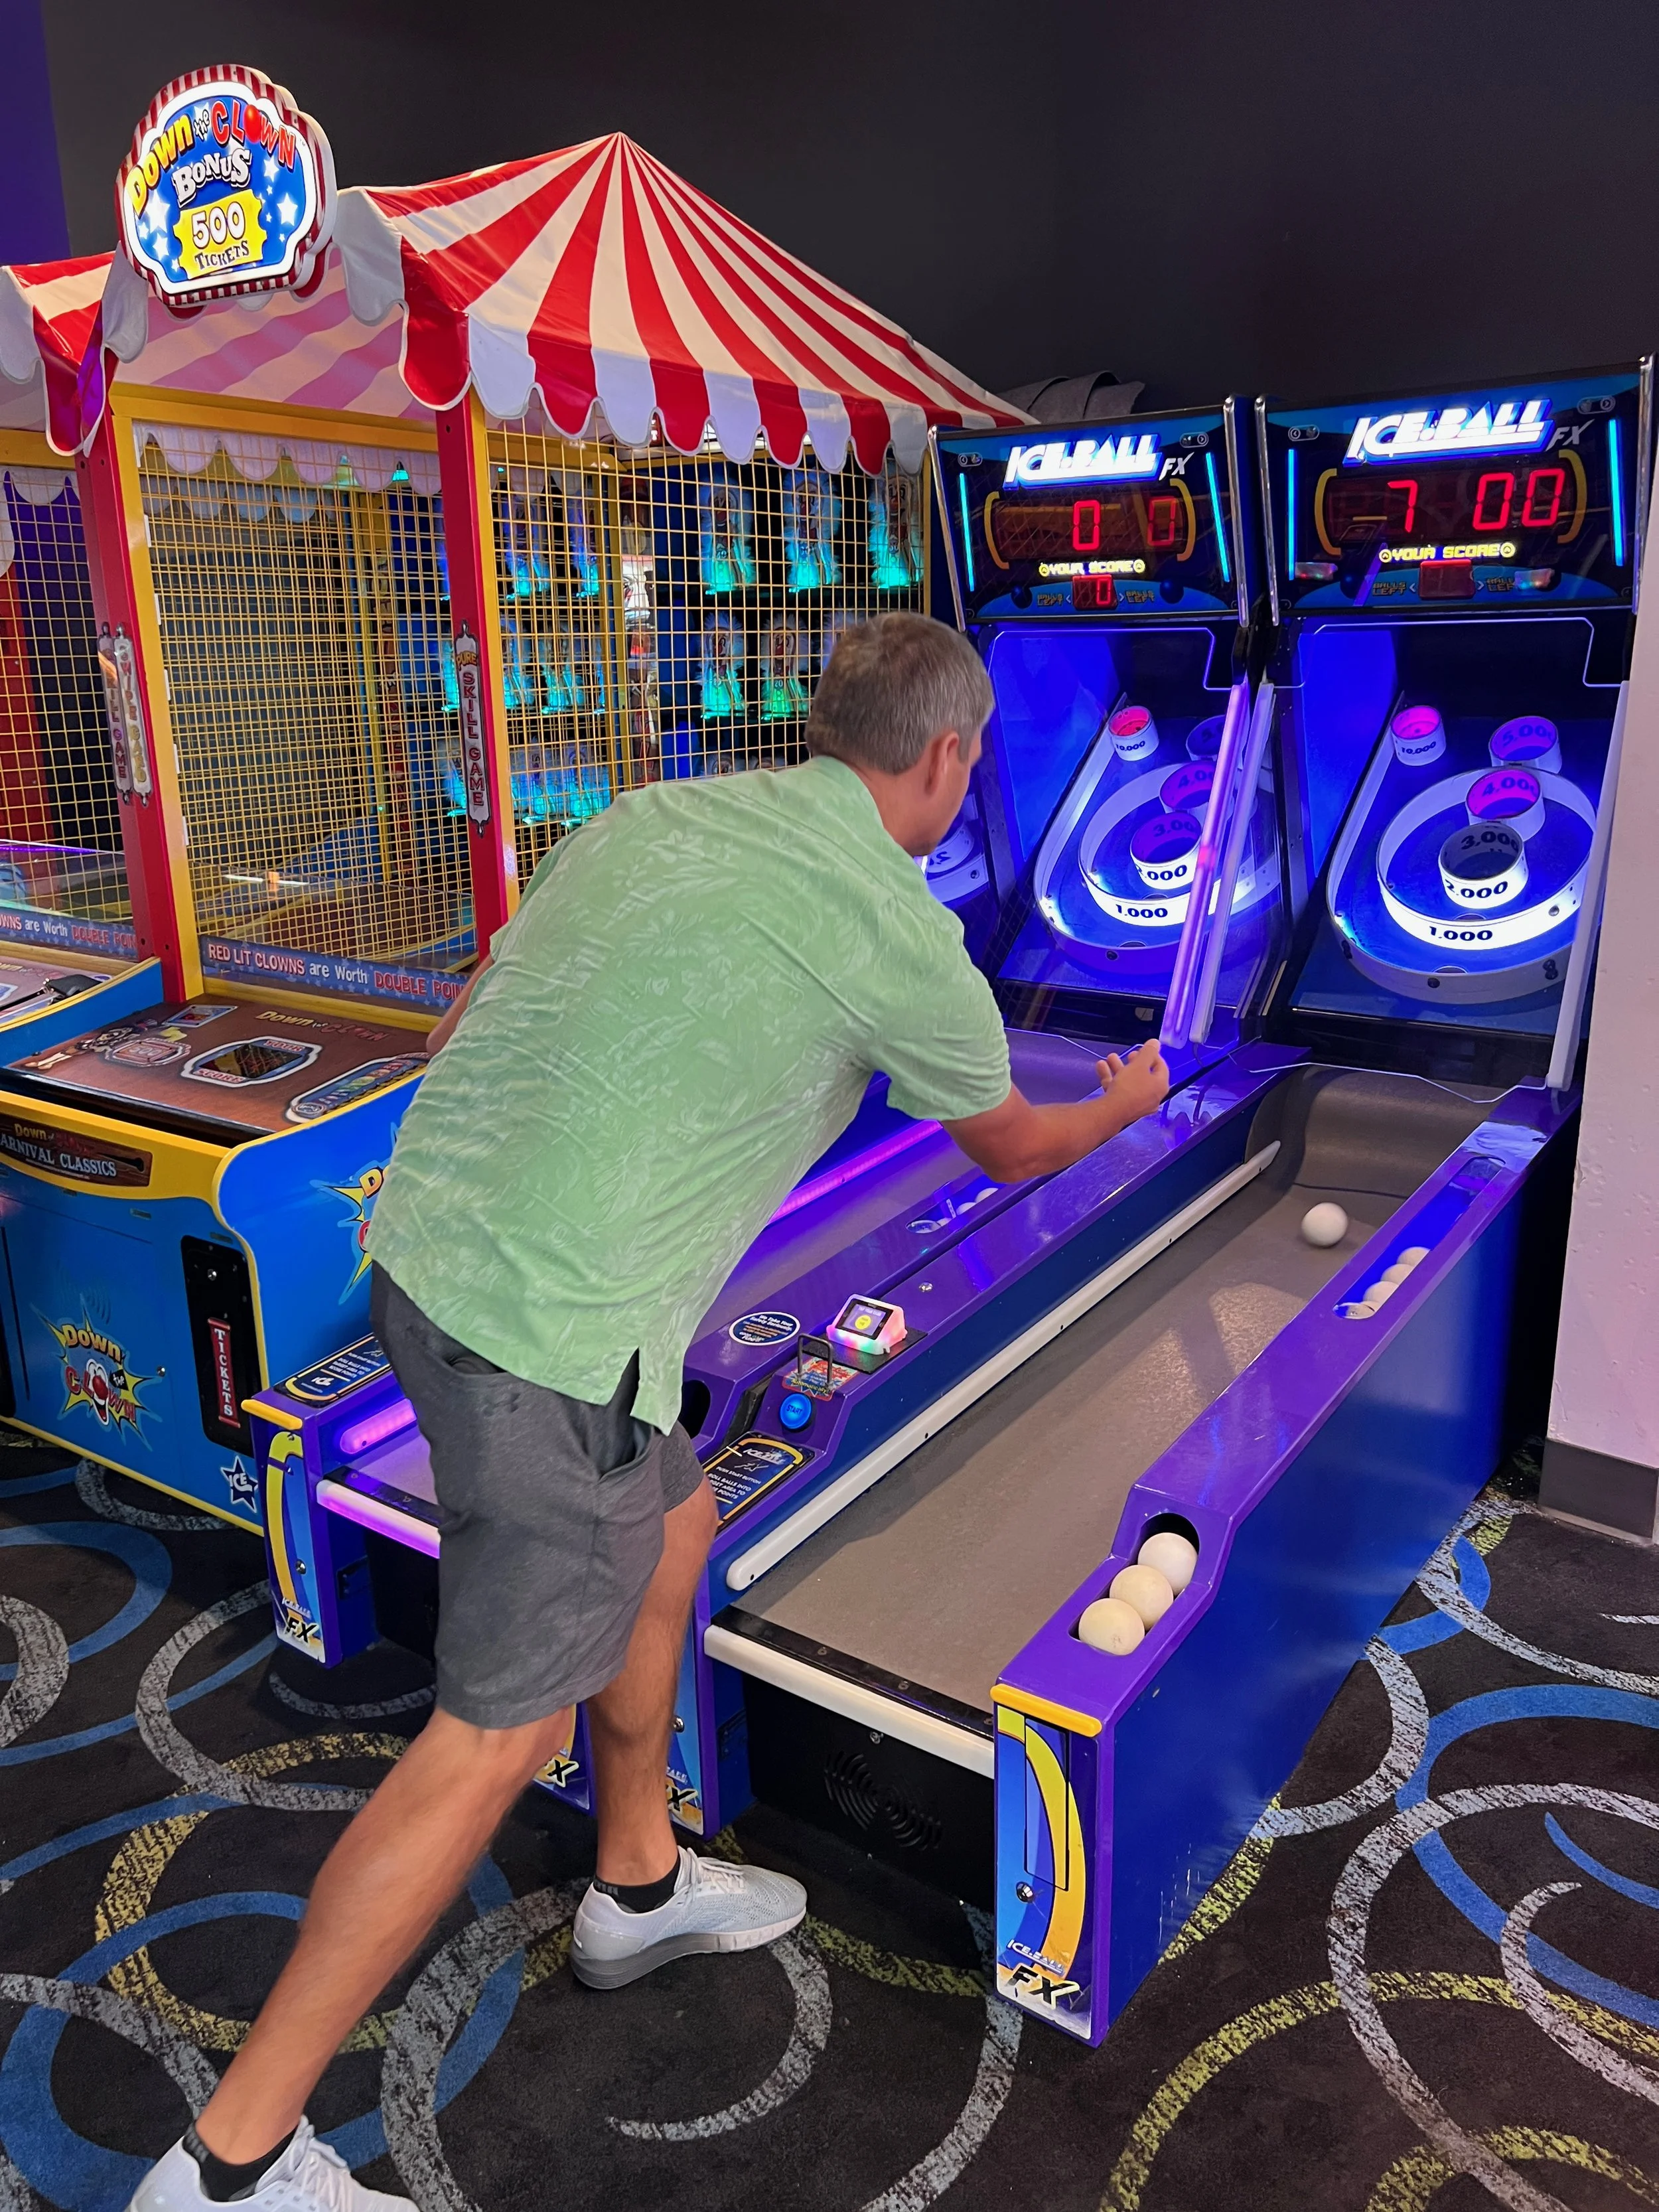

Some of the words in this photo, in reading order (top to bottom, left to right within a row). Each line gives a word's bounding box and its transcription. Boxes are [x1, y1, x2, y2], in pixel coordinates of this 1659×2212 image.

[194, 109, 210, 140] the
[211, 100, 296, 170] CLOWN
[172, 149, 252, 208] BONUS
[191, 201, 246, 249] 500
[195, 240, 250, 269] TICKETS
[1546, 419, 1594, 451] FX
[1159, 451, 1194, 480] FX
[1388, 480, 1418, 532] 7
[1048, 562, 1085, 575] YOUR
[1089, 561, 1133, 573] SCORE
[1392, 546, 1435, 561] YOUR
[1443, 544, 1500, 558] SCORE
[456, 651, 478, 670] PURE
[463, 672, 478, 739] SKILL
[113, 729, 127, 778] GAME
[469, 747, 484, 806] GAME
[25, 919, 40, 932] are
[43, 921, 68, 937] Worth
[72, 924, 109, 945] DOUBLE
[208, 943, 231, 962] RED
[233, 948, 253, 966] LIT
[254, 952, 306, 975] CLOWNS
[309, 961, 330, 978] are
[334, 964, 368, 985] Worth
[374, 970, 427, 995] DOUBLE
[432, 979, 465, 1000] POIN
[14, 1123, 47, 1141] Down
[0, 1133, 55, 1165] ARNIVAL
[60, 1153, 117, 1177] CLASSICS
[62, 1324, 123, 1364] Down
[113, 1373, 125, 1386] the
[214, 1328, 232, 1416] TICKETS
[786, 1404, 802, 1414] START
[229, 1473, 252, 1492] ICE
[717, 1489, 739, 1500] POINTS
[721, 1477, 738, 1486] BALLS
[285, 1617, 319, 1645] FX
[1005, 1964, 1076, 2006] FX
